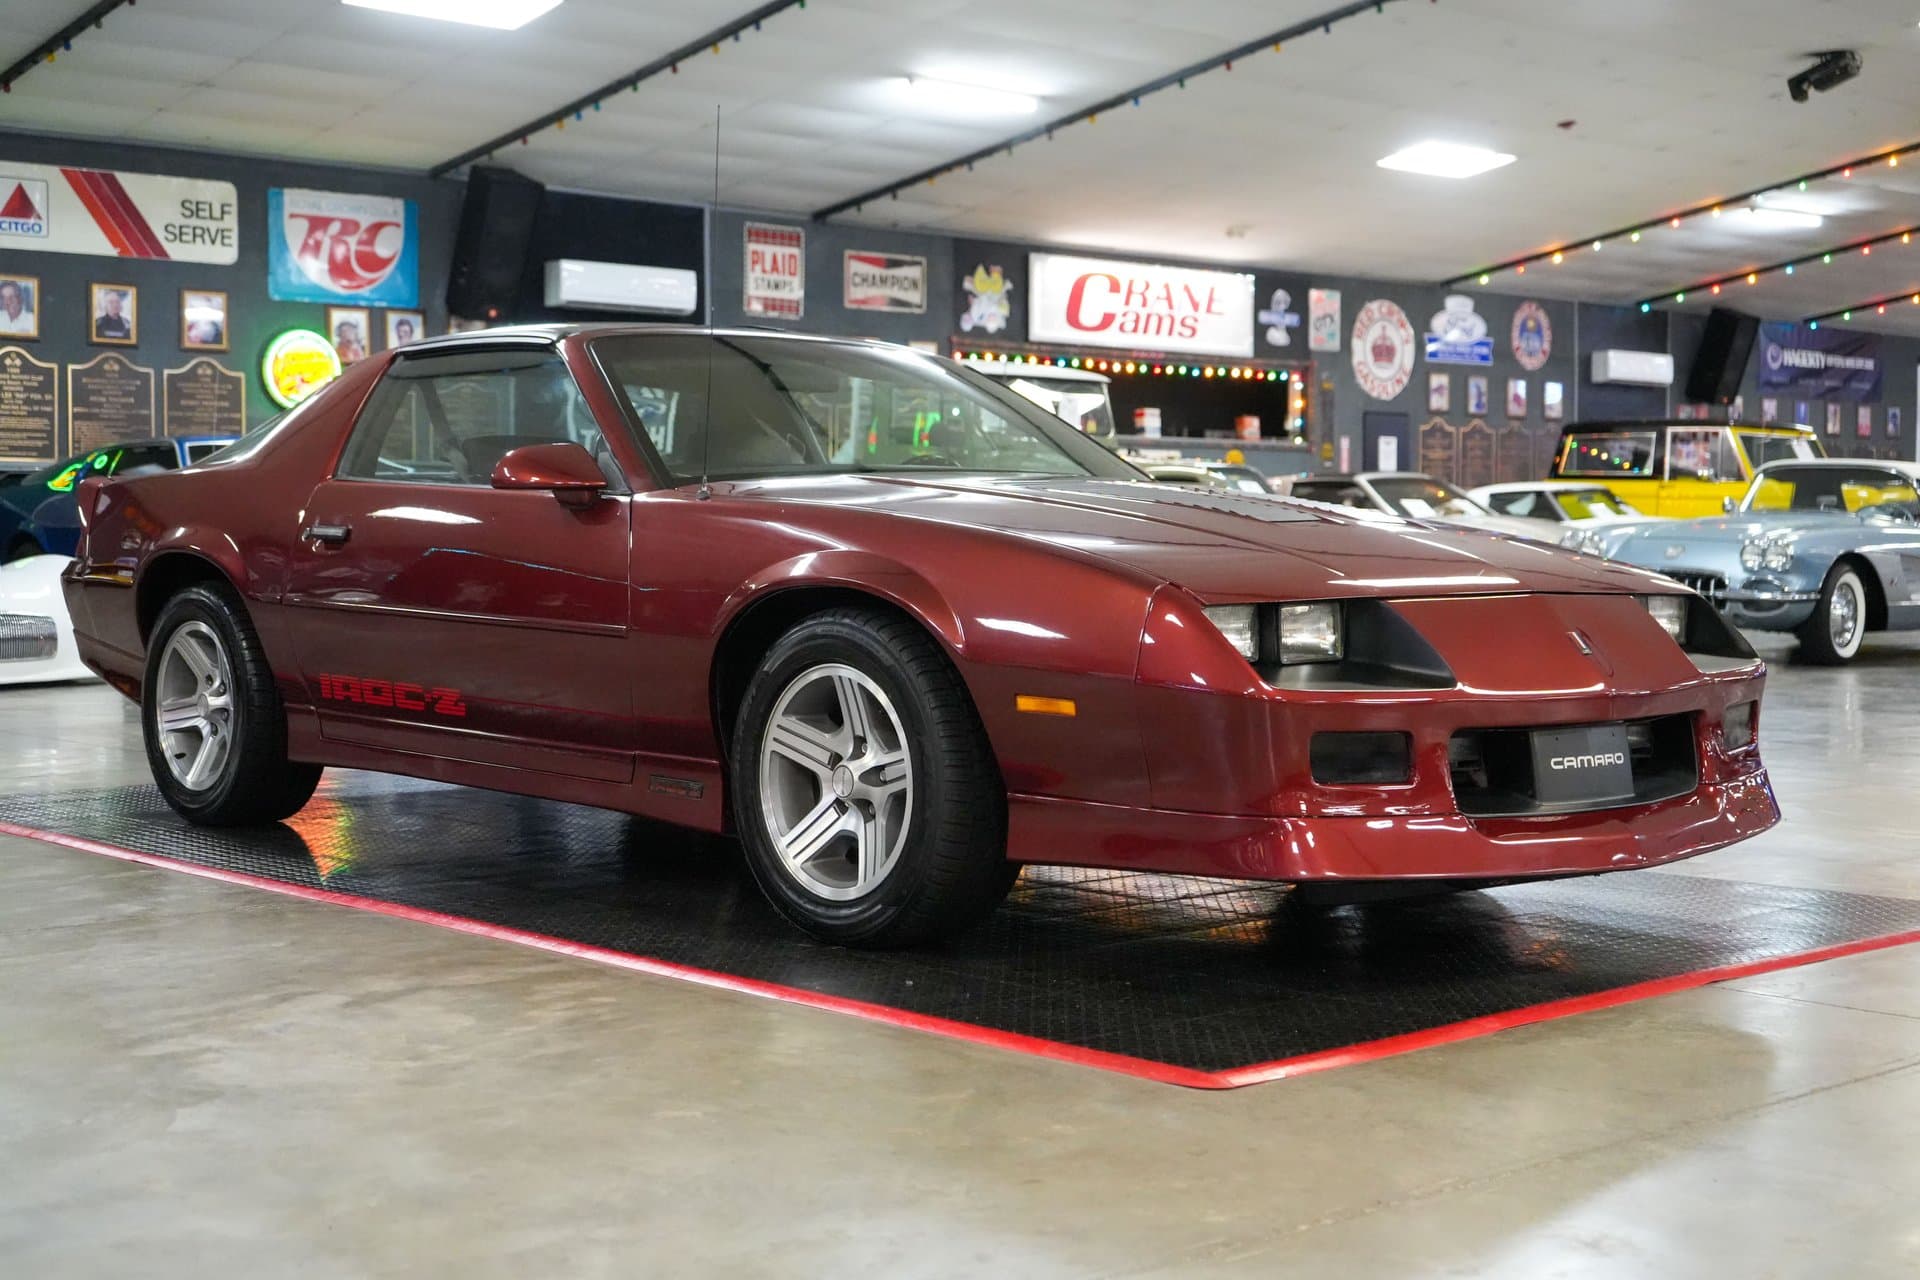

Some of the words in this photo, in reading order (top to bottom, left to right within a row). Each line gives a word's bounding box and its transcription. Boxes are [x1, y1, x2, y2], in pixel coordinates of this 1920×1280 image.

[180, 199, 233, 221] SELF
[0, 220, 42, 234] CITGO
[163, 222, 234, 248] SERVE
[288, 213, 402, 291] RC
[751, 250, 798, 277] PLAID
[753, 276, 796, 293] STAMPS
[851, 270, 920, 291] CHAMPION
[1066, 272, 1225, 332] CRANE
[319, 672, 467, 718] IROC-Z
[1550, 752, 1625, 770] CAMARO
